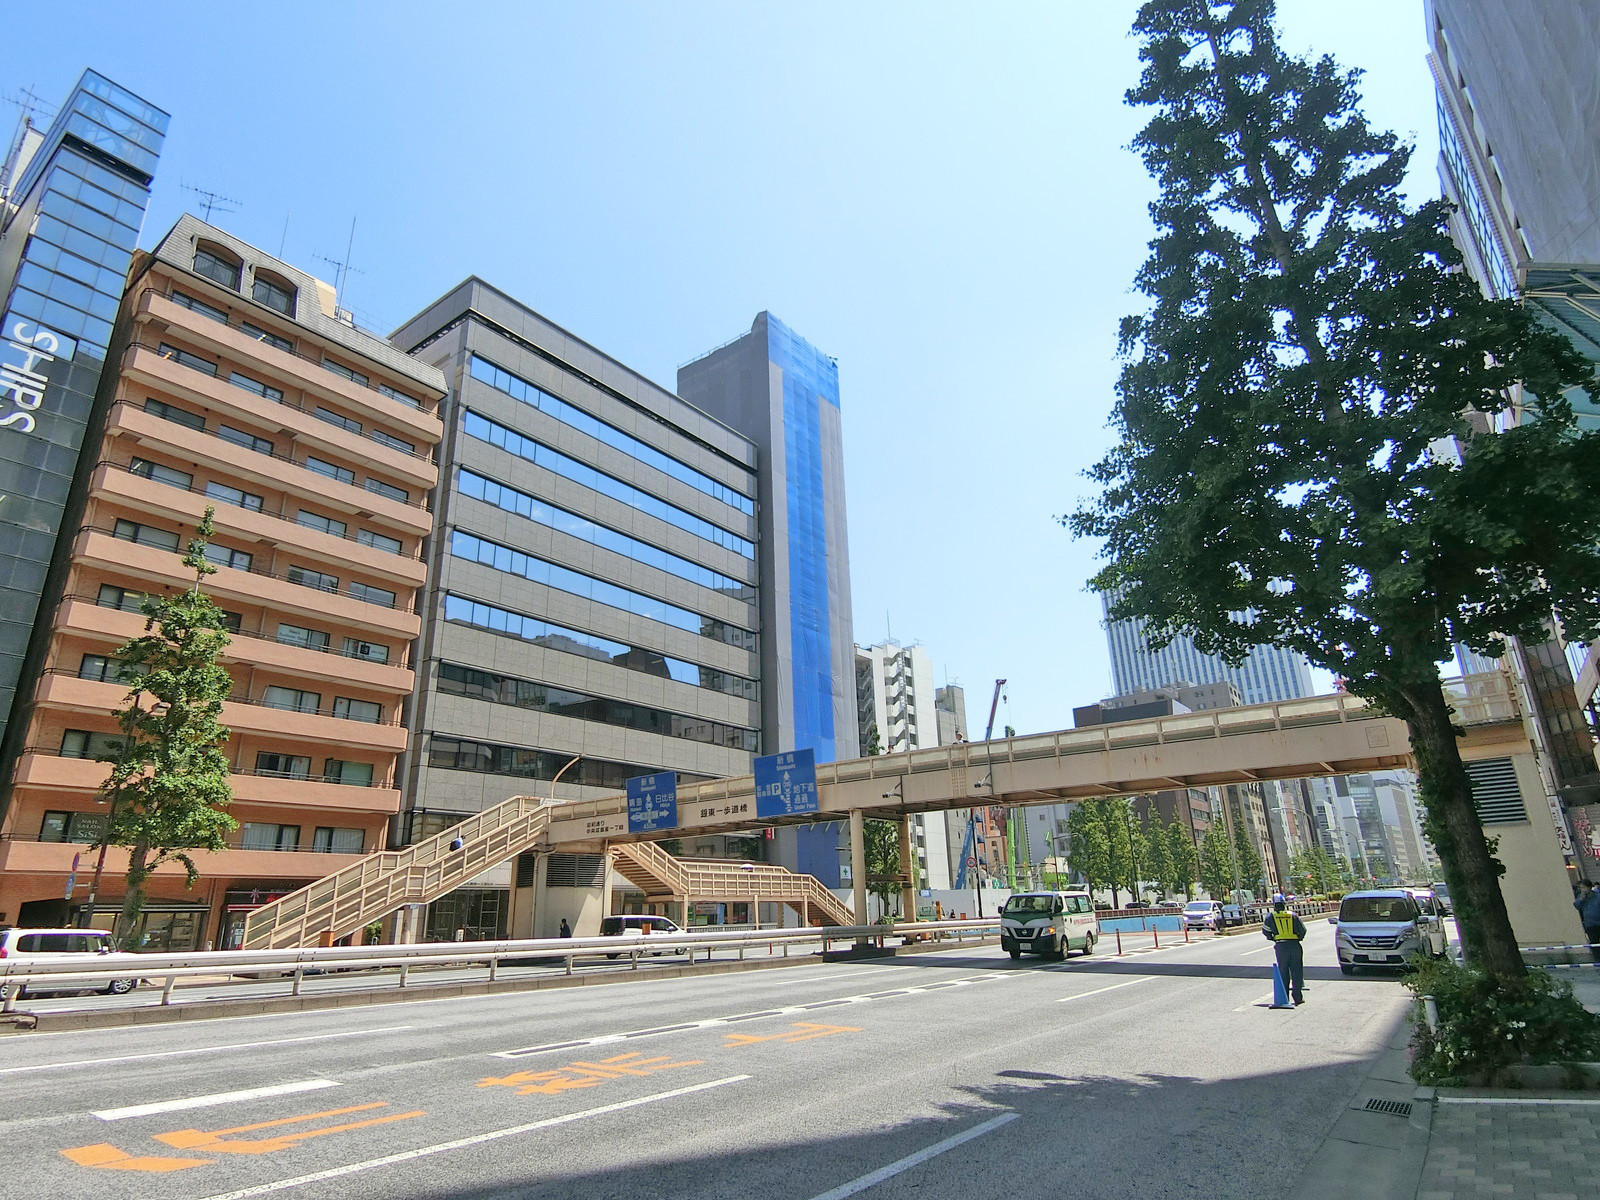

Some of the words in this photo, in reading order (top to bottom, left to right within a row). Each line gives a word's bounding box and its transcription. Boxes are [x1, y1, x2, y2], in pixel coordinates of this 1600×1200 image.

[0, 322, 59, 433] SHIPS
[793, 783, 814, 793] 地下道
[656, 793, 674, 803] 日比谷
